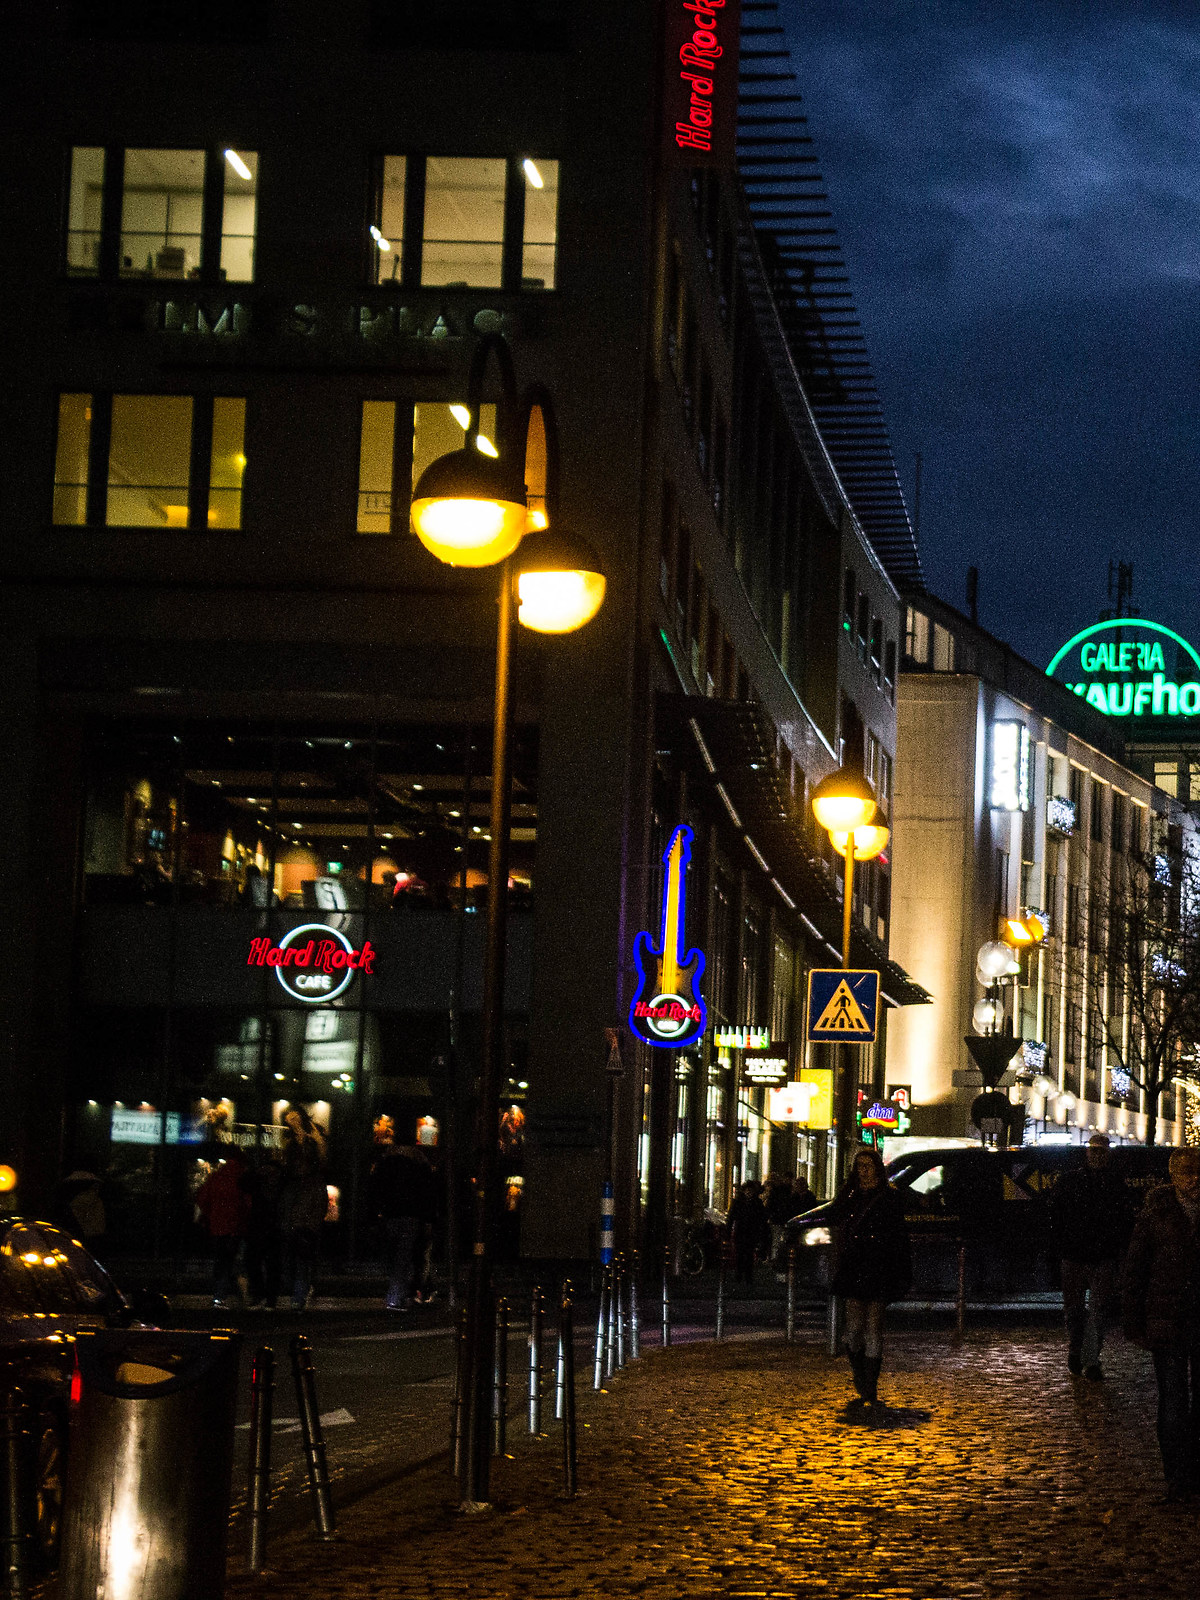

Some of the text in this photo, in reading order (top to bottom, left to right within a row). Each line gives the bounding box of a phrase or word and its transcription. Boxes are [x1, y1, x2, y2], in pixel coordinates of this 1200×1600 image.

[675, 0, 726, 151] Hard Rock
[1080, 641, 1166, 673] GALERIA
[247, 937, 376, 974] Hard Rock
[295, 974, 332, 990] CAFE
[634, 1001, 702, 1022] Hard Rock
[866, 1102, 894, 1119] dm
